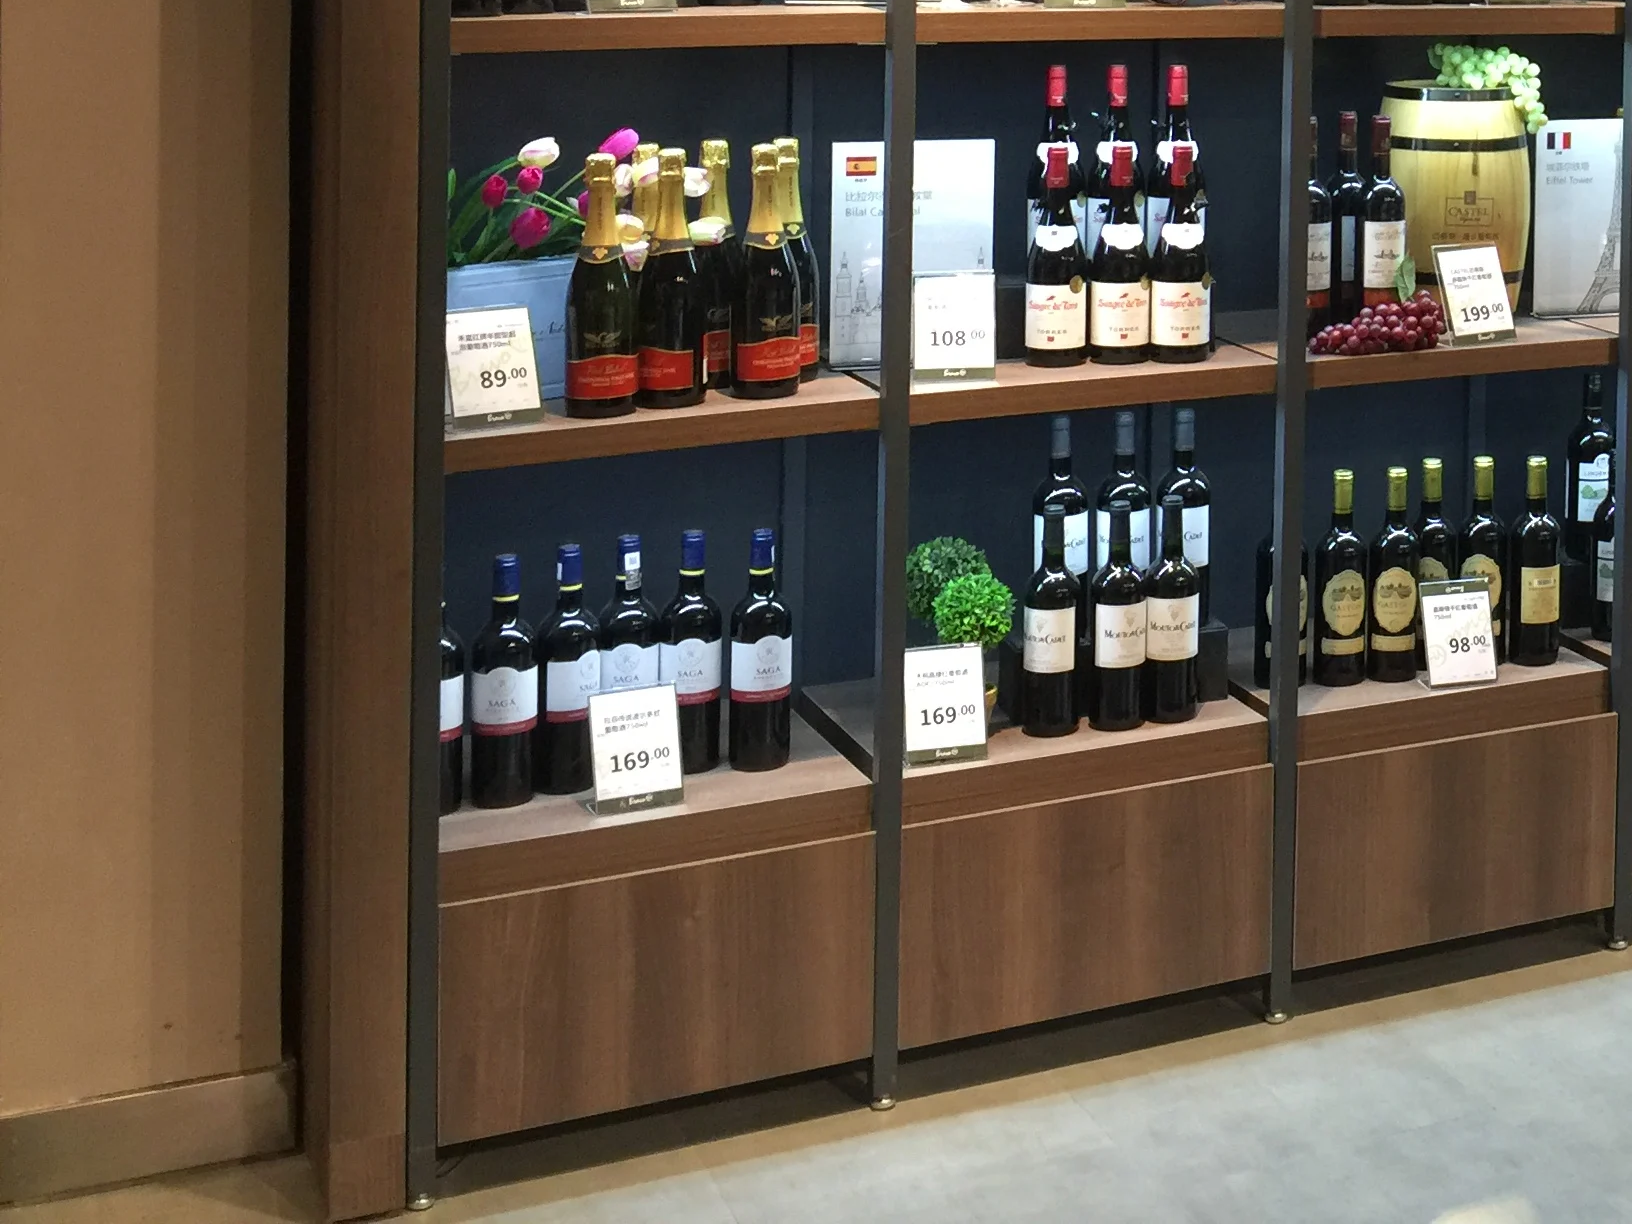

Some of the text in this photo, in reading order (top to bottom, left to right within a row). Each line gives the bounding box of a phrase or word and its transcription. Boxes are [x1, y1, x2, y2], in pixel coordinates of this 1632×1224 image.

[1570, 176, 1593, 185] Tower
[1447, 206, 1488, 217] CASTEL
[931, 330, 966, 346] 108
[480, 367, 527, 389] 89.00
[1449, 635, 1486, 653] 98.00
[677, 669, 703, 677] SAGA
[756, 666, 781, 676] SAGA
[613, 675, 640, 683] SAGA
[610, 746, 670, 773] 169.00
